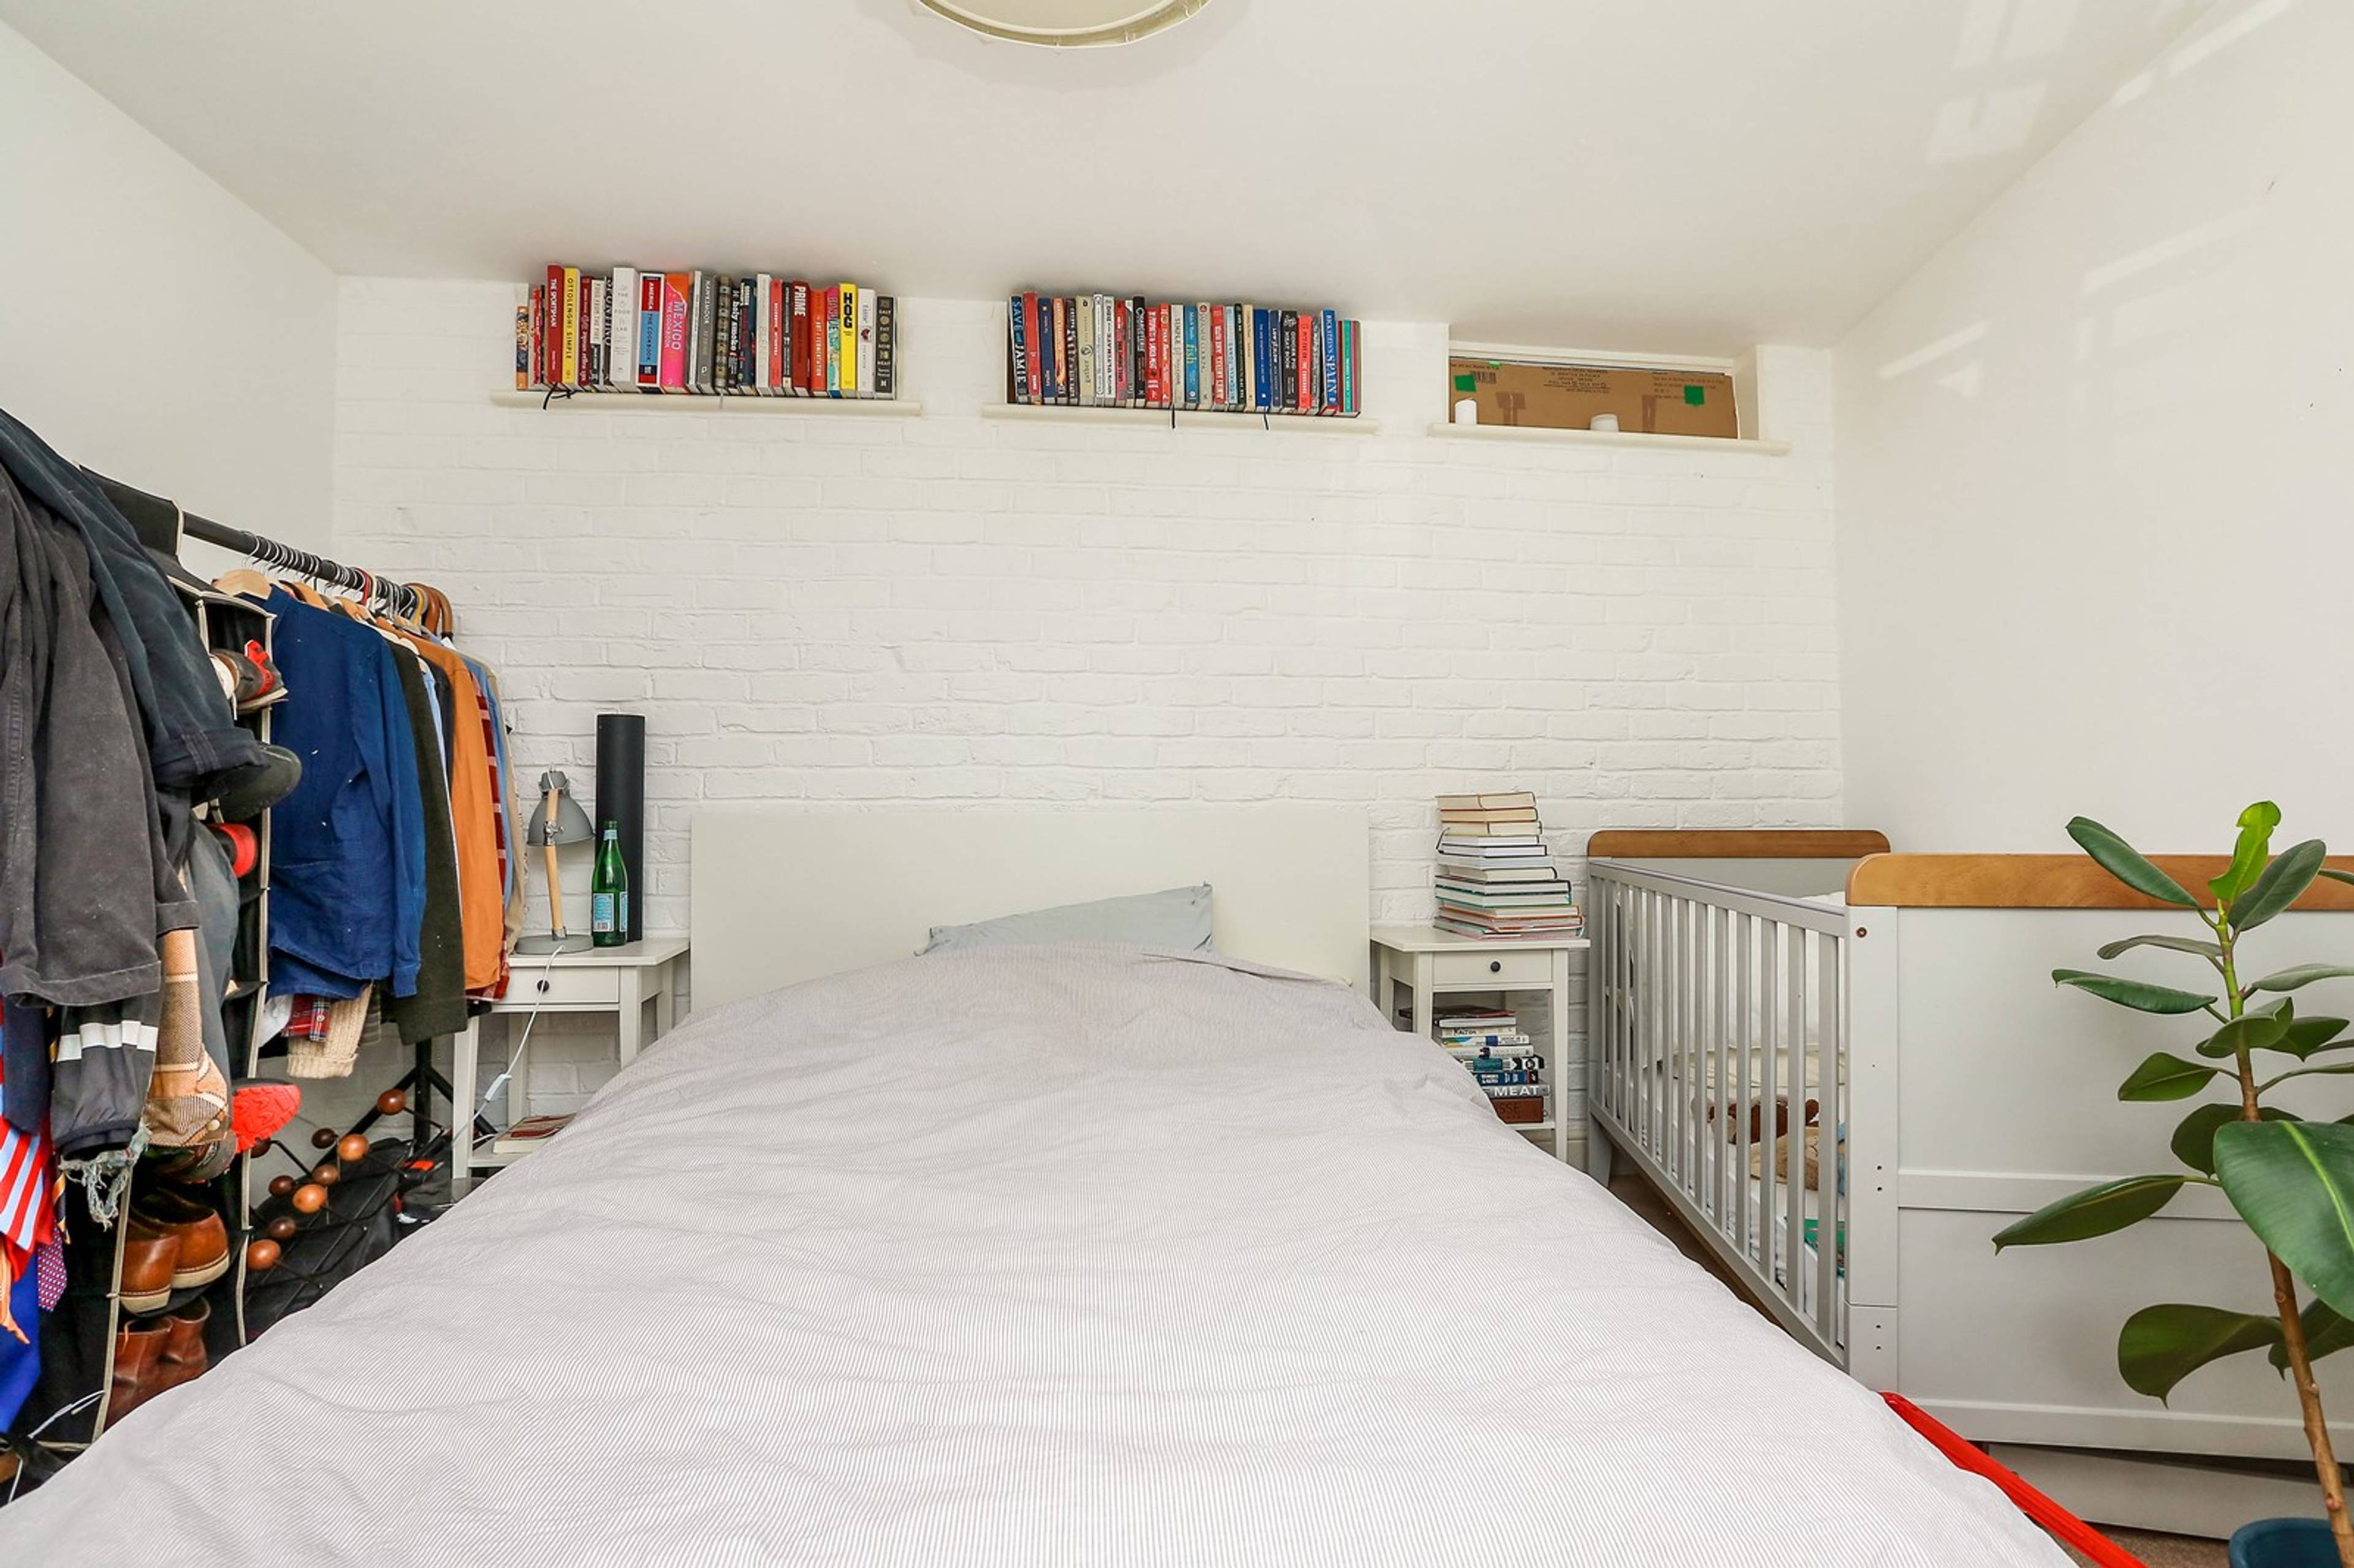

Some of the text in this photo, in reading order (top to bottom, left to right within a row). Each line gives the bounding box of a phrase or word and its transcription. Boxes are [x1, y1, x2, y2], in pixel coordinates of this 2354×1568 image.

[794, 285, 806, 317] PRIME
[844, 292, 852, 329] HOG
[1013, 301, 1023, 330] SAVE
[671, 301, 684, 350] MEXICO
[1015, 343, 1026, 383] JAMIE
[1186, 343, 1197, 364] fish
[1327, 354, 1337, 393] SPAIN
[1494, 1086, 1539, 1096] MEAT
